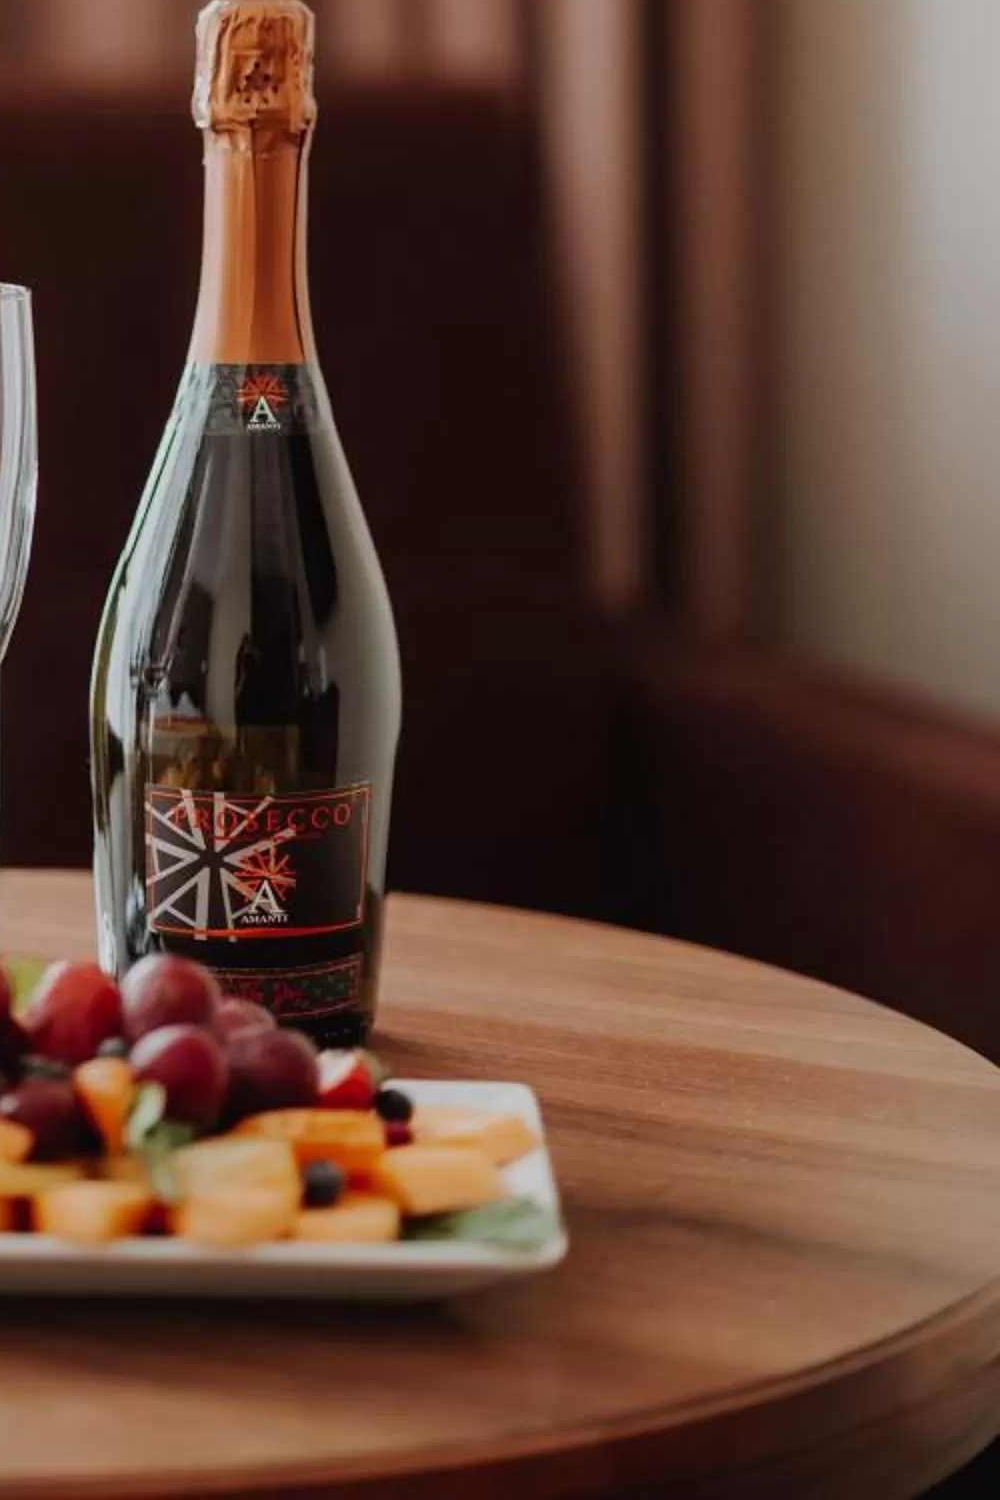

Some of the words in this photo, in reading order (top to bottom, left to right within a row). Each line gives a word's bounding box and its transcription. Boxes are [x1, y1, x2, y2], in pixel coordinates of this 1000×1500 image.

[249, 396, 278, 423] A
[174, 803, 352, 833] PROSECCO
[249, 879, 286, 914] A
[241, 914, 290, 924] AMANTI
